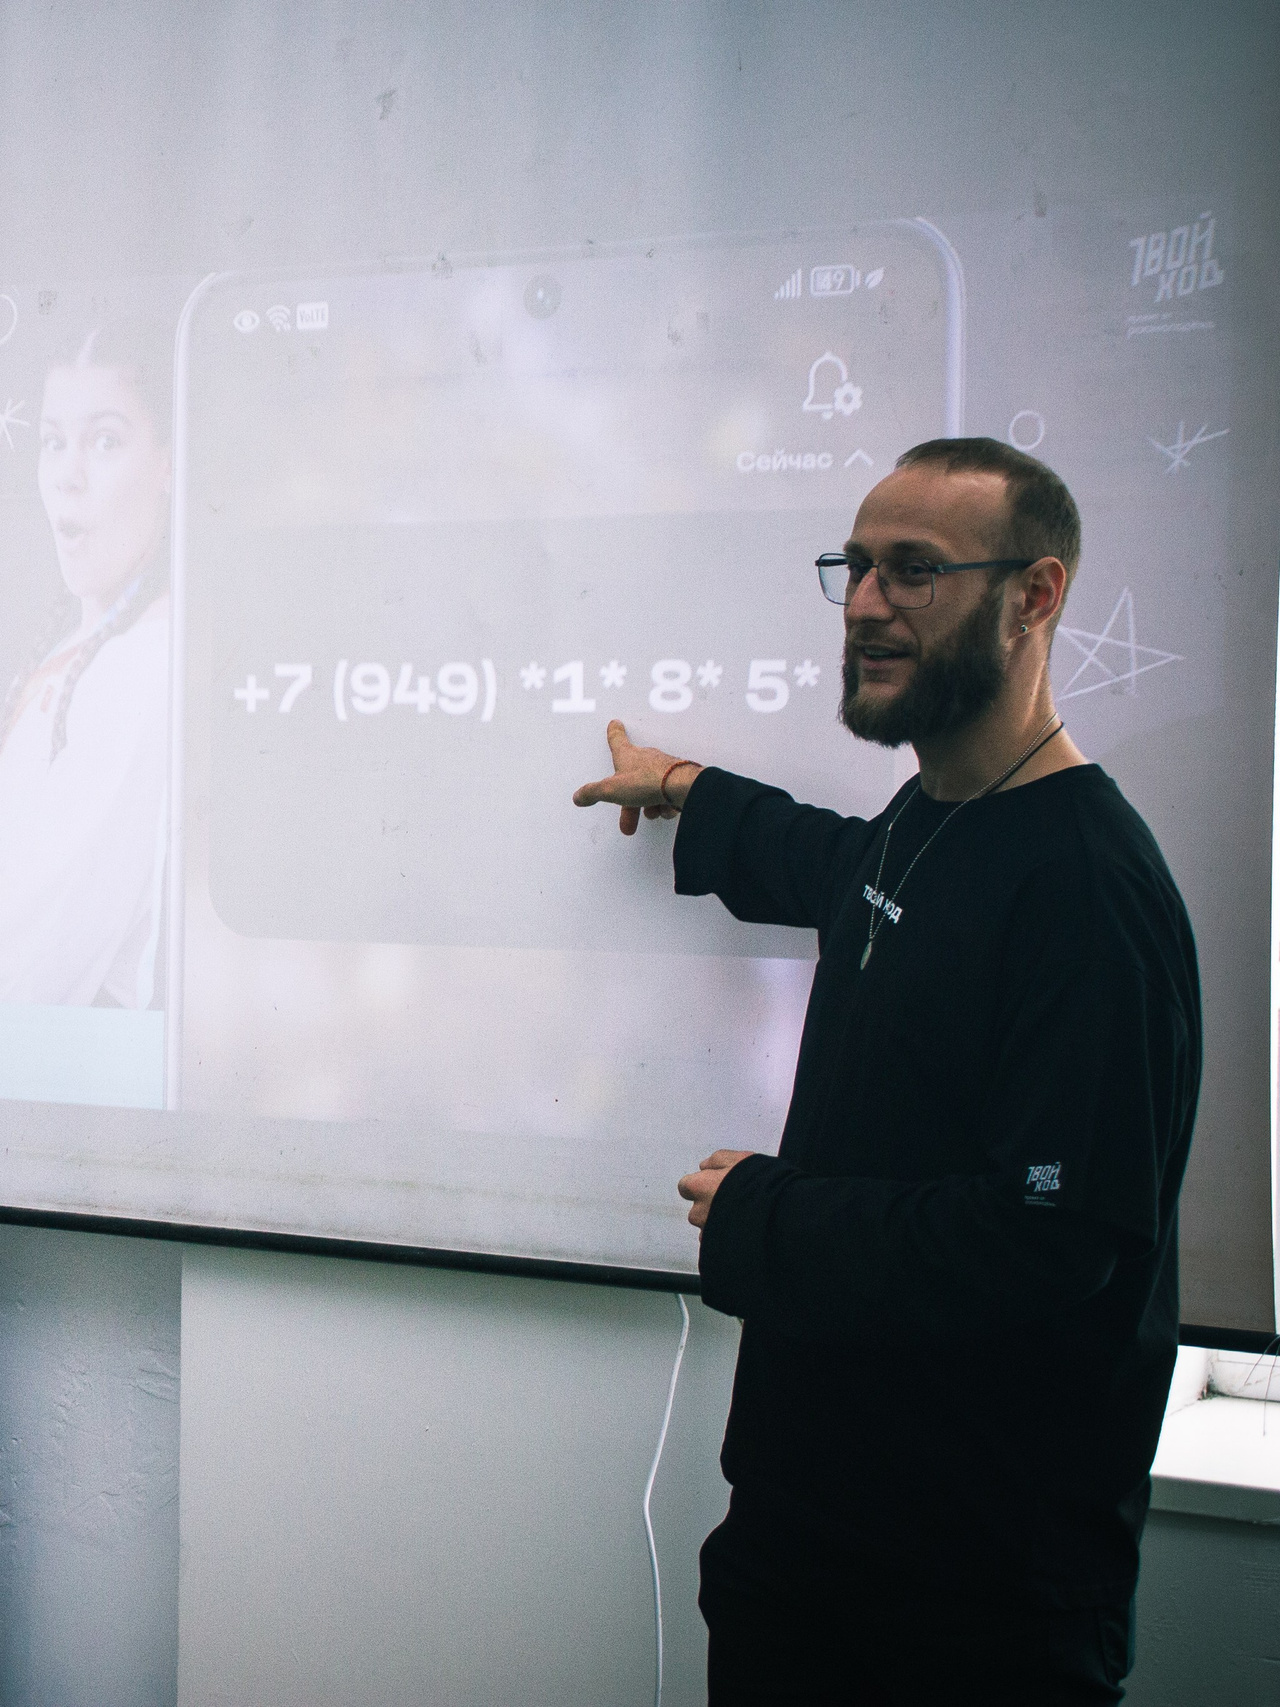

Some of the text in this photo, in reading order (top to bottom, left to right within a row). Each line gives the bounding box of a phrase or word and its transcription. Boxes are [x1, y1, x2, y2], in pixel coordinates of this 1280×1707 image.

[1129, 211, 1215, 287] ТВОЙ
[1154, 260, 1224, 303] ХОД
[736, 449, 834, 472] Сейчас
[233, 662, 313, 713] +7
[333, 658, 497, 722] (949)
[1026, 1161, 1061, 1185] ТВОЙ
[1033, 1179, 1061, 1192] ХОД
